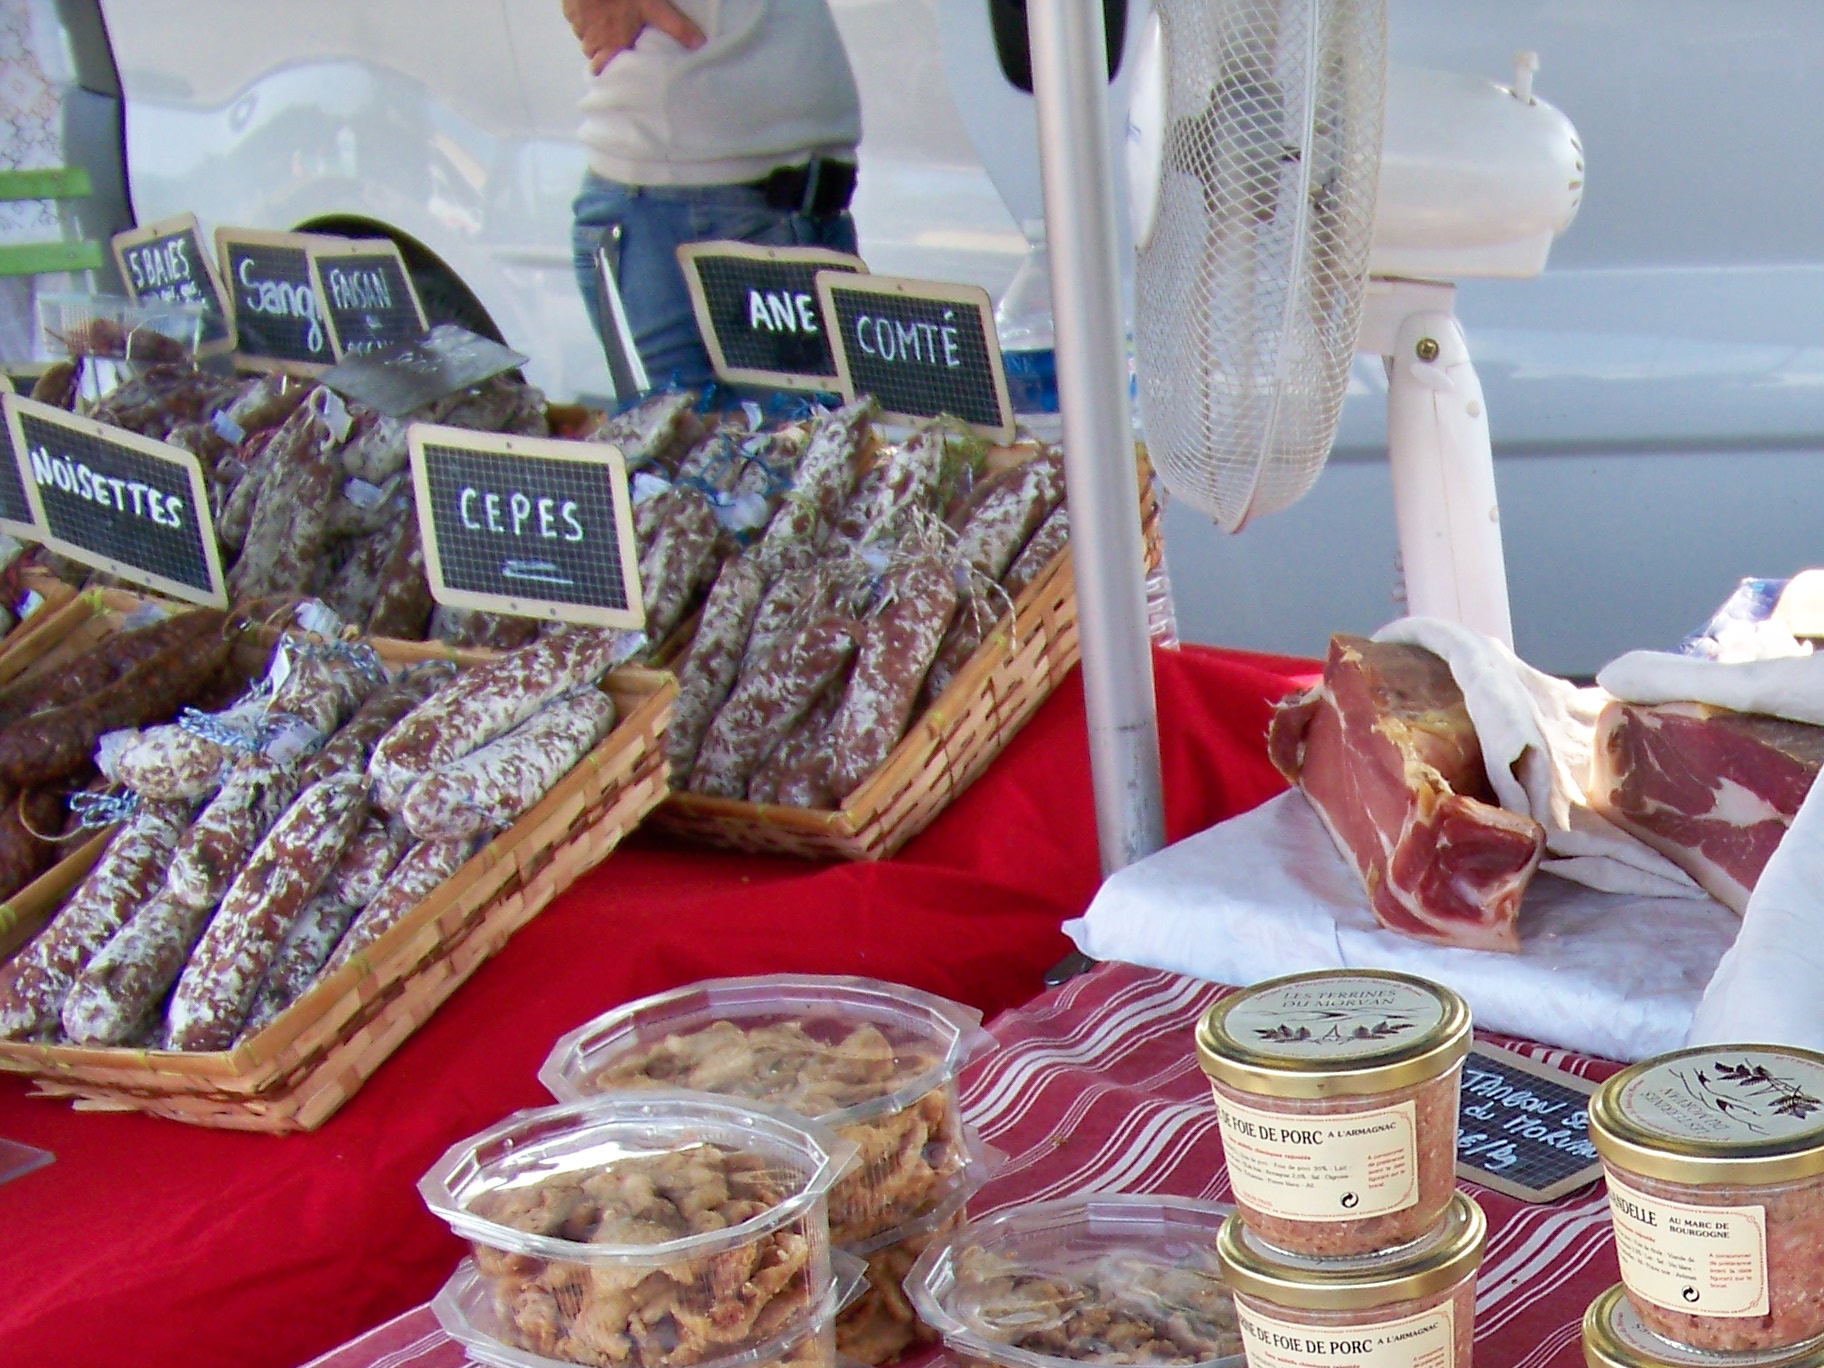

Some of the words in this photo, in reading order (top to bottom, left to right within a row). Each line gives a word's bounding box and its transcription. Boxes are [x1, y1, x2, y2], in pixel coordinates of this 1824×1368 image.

[239, 257, 324, 352] Sang
[749, 289, 819, 334] ANE
[856, 310, 961, 367] COMTÉ
[459, 485, 585, 542] CEPES
[1232, 1116, 1257, 1138] FOIE
[1259, 1126, 1278, 1142] DE
[1281, 1129, 1323, 1145] PORC
[1338, 1122, 1397, 1138] L'ARMAGNAC
[1669, 1216, 1681, 1224] AU
[1684, 1218, 1712, 1229] MARC
[1715, 1222, 1730, 1230] DE
[1669, 1226, 1730, 1239] BOURGOGNE
[1256, 1327, 1272, 1345] DE
[1273, 1333, 1303, 1353] FOIE
[1306, 1340, 1326, 1355] DE
[1330, 1339, 1373, 1355] PORC
[1386, 1322, 1440, 1344] L'ARMAGNAC
